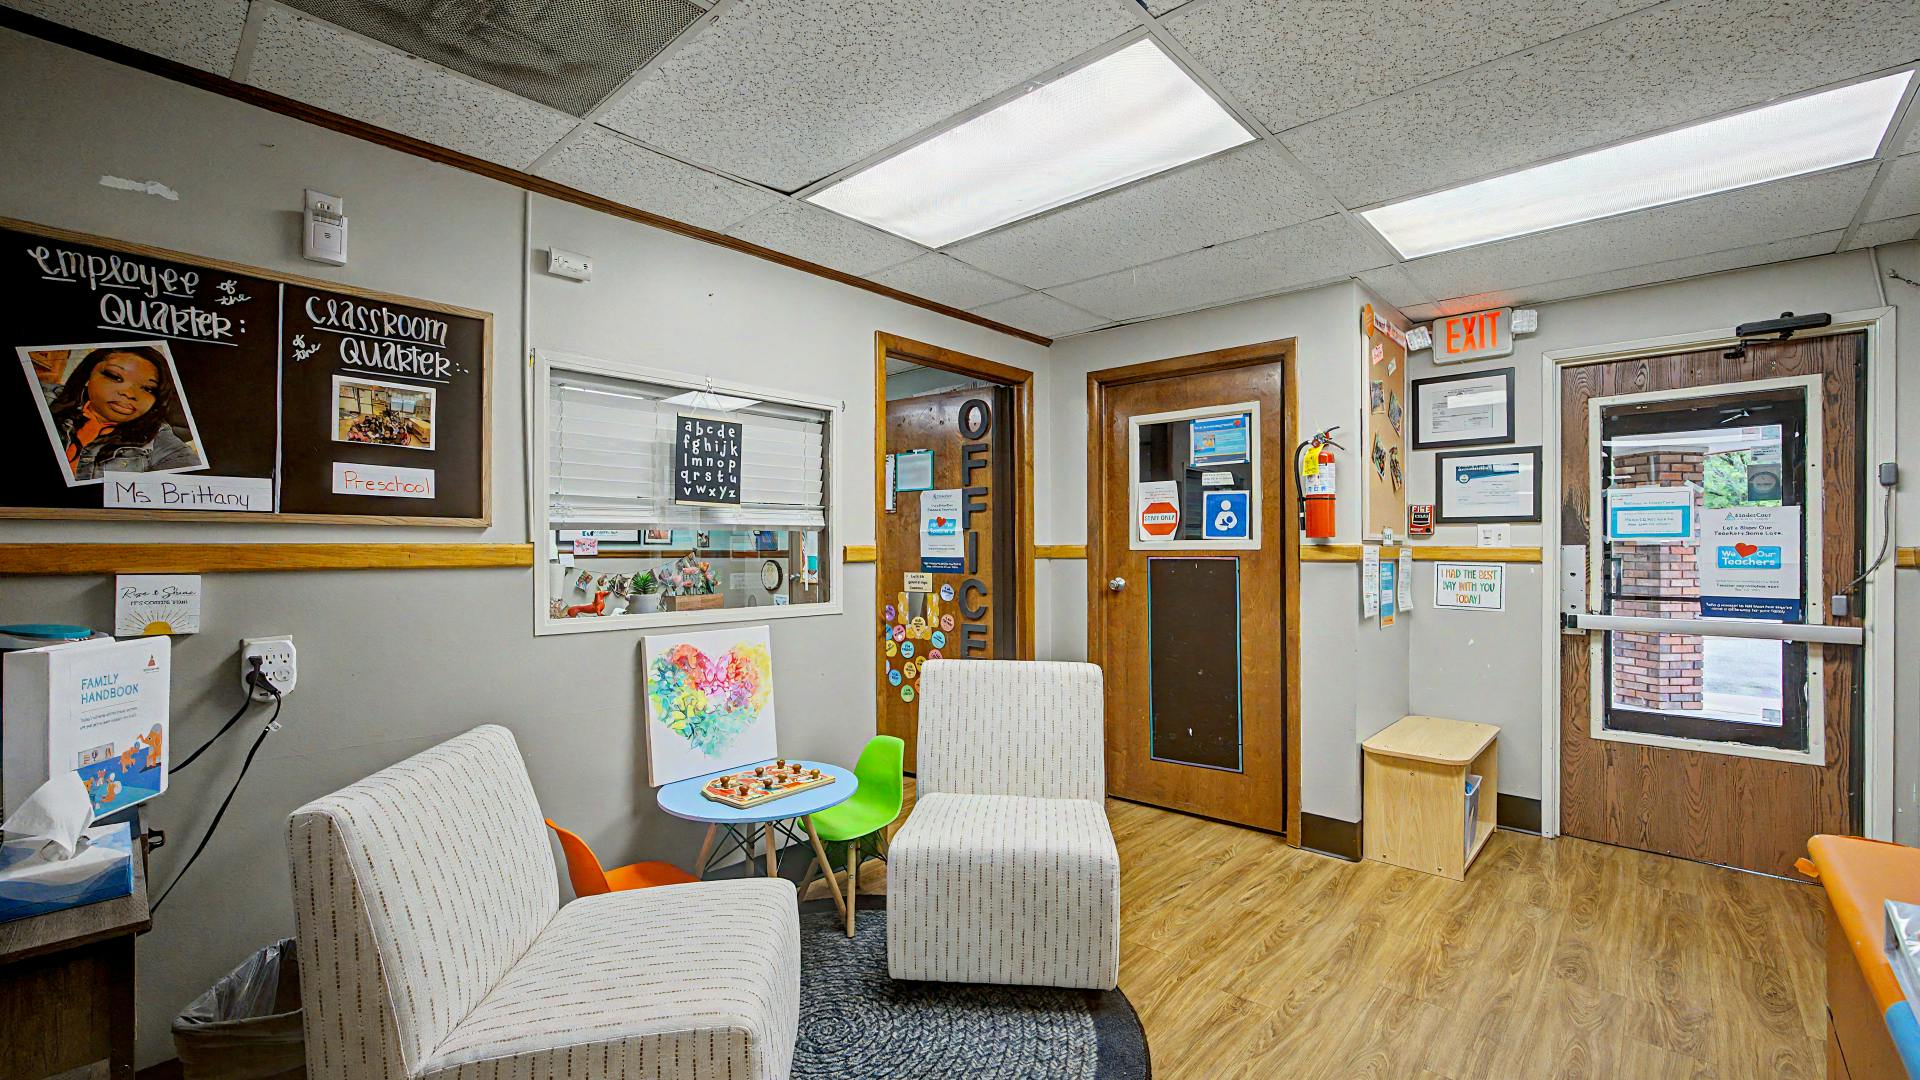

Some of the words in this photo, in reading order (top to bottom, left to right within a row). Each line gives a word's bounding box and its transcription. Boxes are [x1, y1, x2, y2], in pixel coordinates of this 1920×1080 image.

[1446, 311, 1502, 353] EXIT
[344, 470, 430, 494] Preschool
[115, 481, 151, 503] Ms
[161, 481, 249, 510] Brittany
[1721, 557, 1775, 566] Teachers
[1756, 550, 1777, 558] Our
[1445, 569, 1461, 579] HAD
[1463, 569, 1477, 579] THE
[1479, 570, 1498, 580] BEST
[1443, 581, 1457, 591] DAY
[1459, 582, 1477, 592] WITH
[1480, 582, 1495, 592] YOU
[81, 673, 119, 690] FAMILY
[81, 683, 139, 705] HANDBOOK
